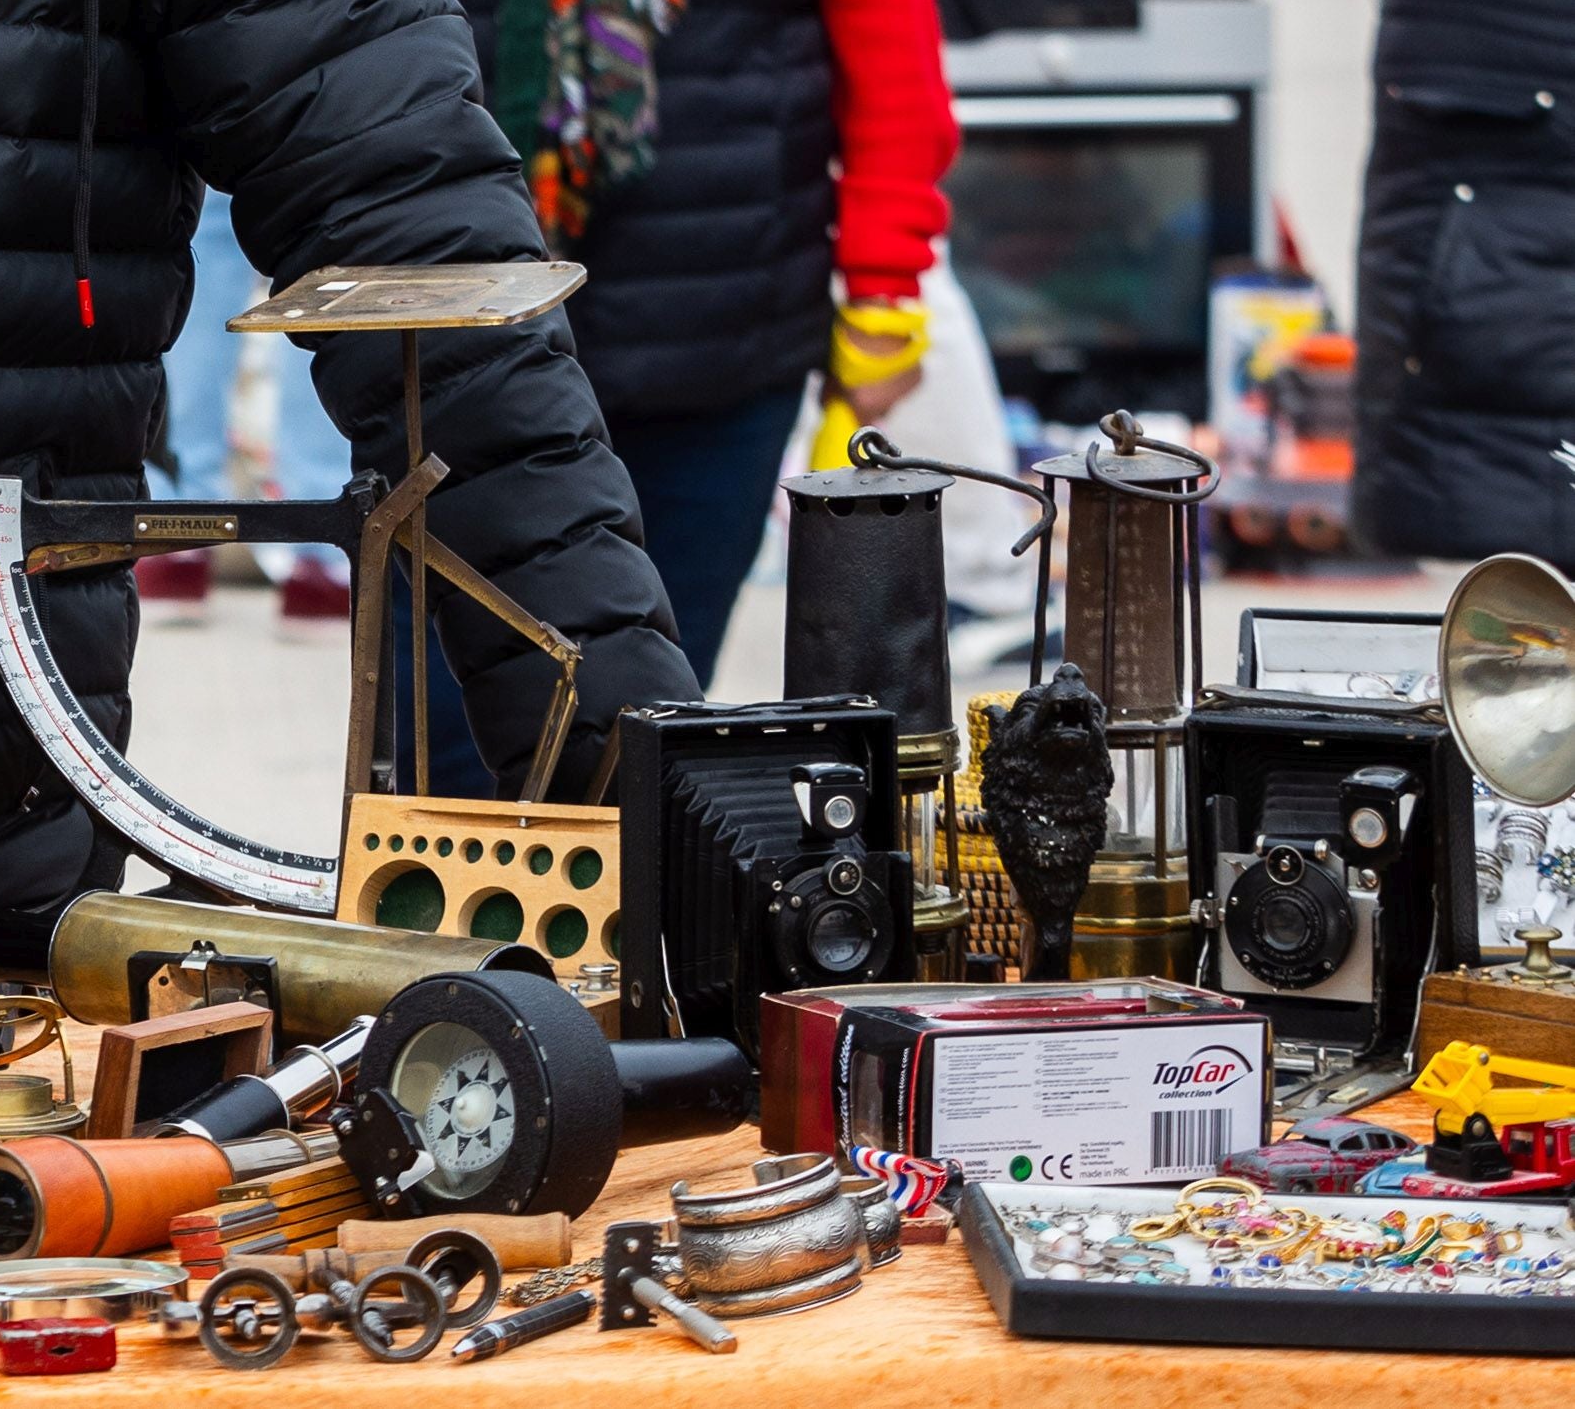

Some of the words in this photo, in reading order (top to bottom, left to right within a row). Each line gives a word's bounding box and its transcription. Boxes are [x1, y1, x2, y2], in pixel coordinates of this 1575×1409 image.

[0, 506, 18, 515] 500
[95, 792, 117, 803] 1000
[838, 1023, 856, 1084] edition
[1152, 1060, 1236, 1090] TopCar
[1158, 1090, 1213, 1100] collection
[1079, 1170, 1102, 1179] made
[1104, 1169, 1112, 1178] in
[1113, 1167, 1130, 1177] PRC
